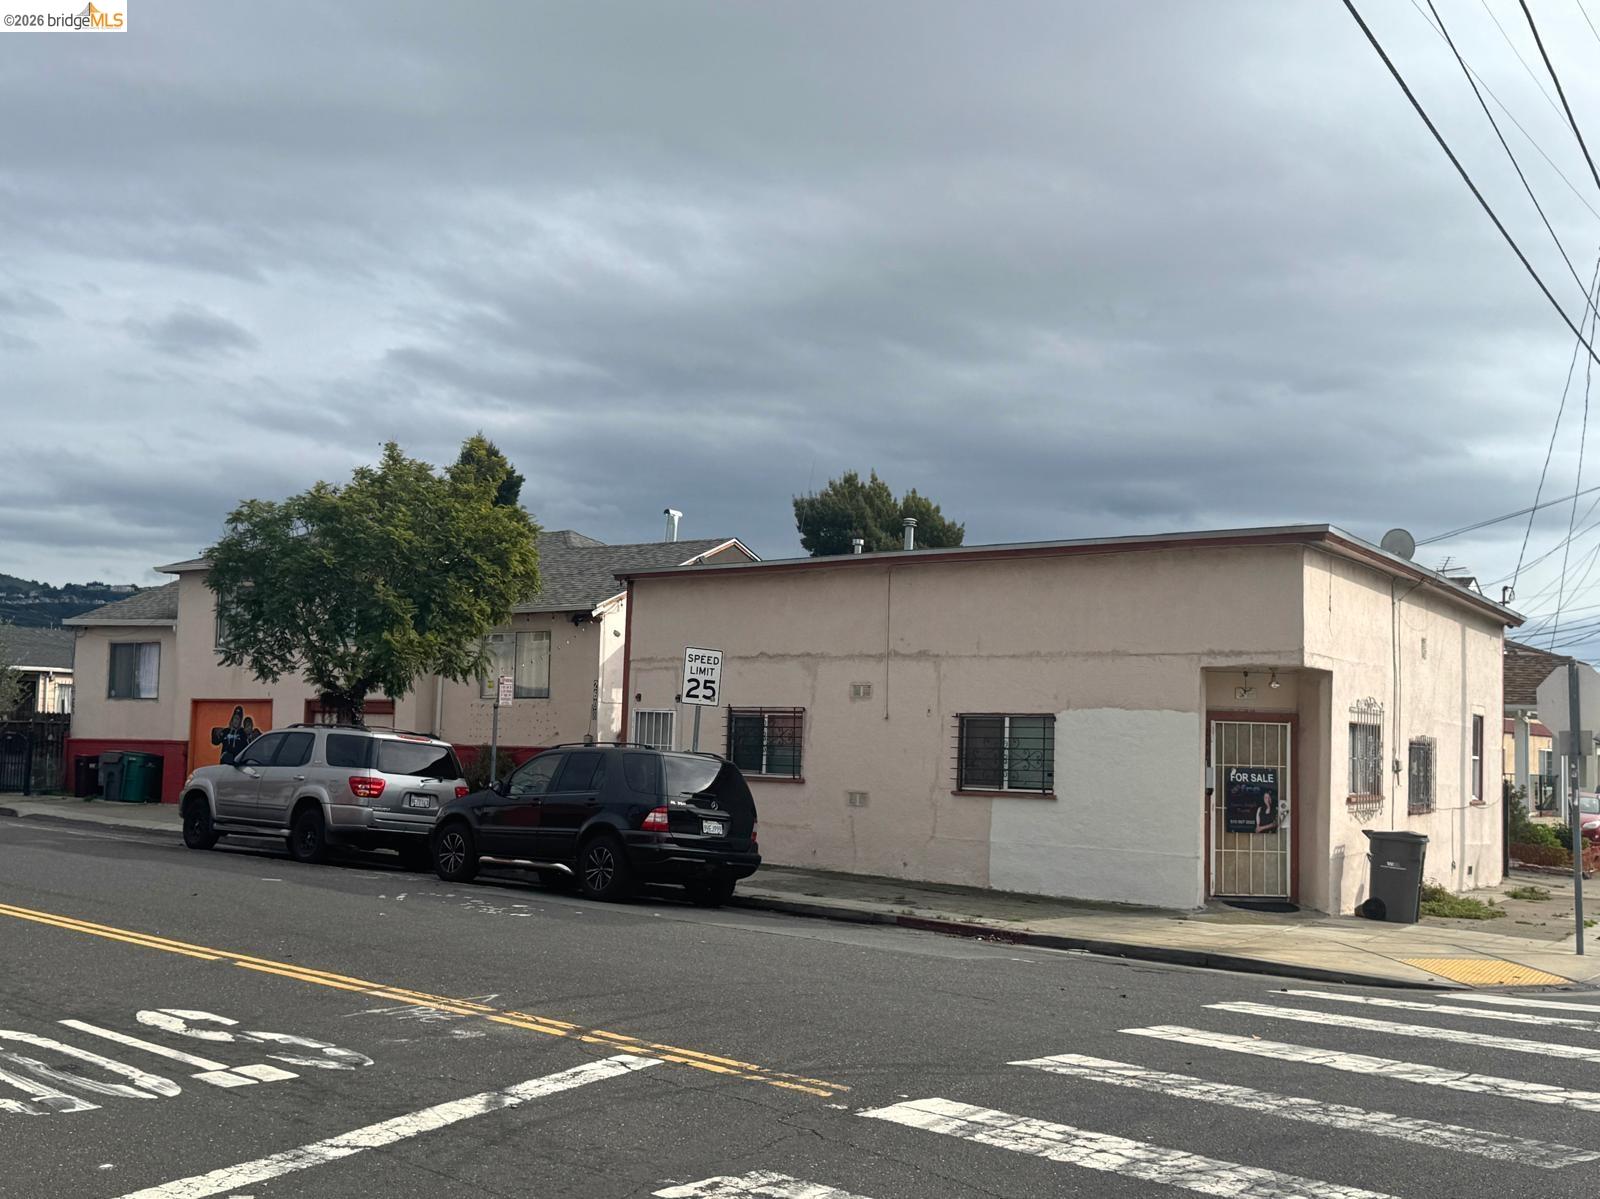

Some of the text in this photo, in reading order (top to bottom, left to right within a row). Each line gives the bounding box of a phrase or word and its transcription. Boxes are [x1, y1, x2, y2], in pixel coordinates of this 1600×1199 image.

[688, 653, 720, 665] SPEED
[690, 666, 715, 676] LIMIT
[686, 678, 716, 700] 25
[1230, 773, 1274, 783] FOR SALE
